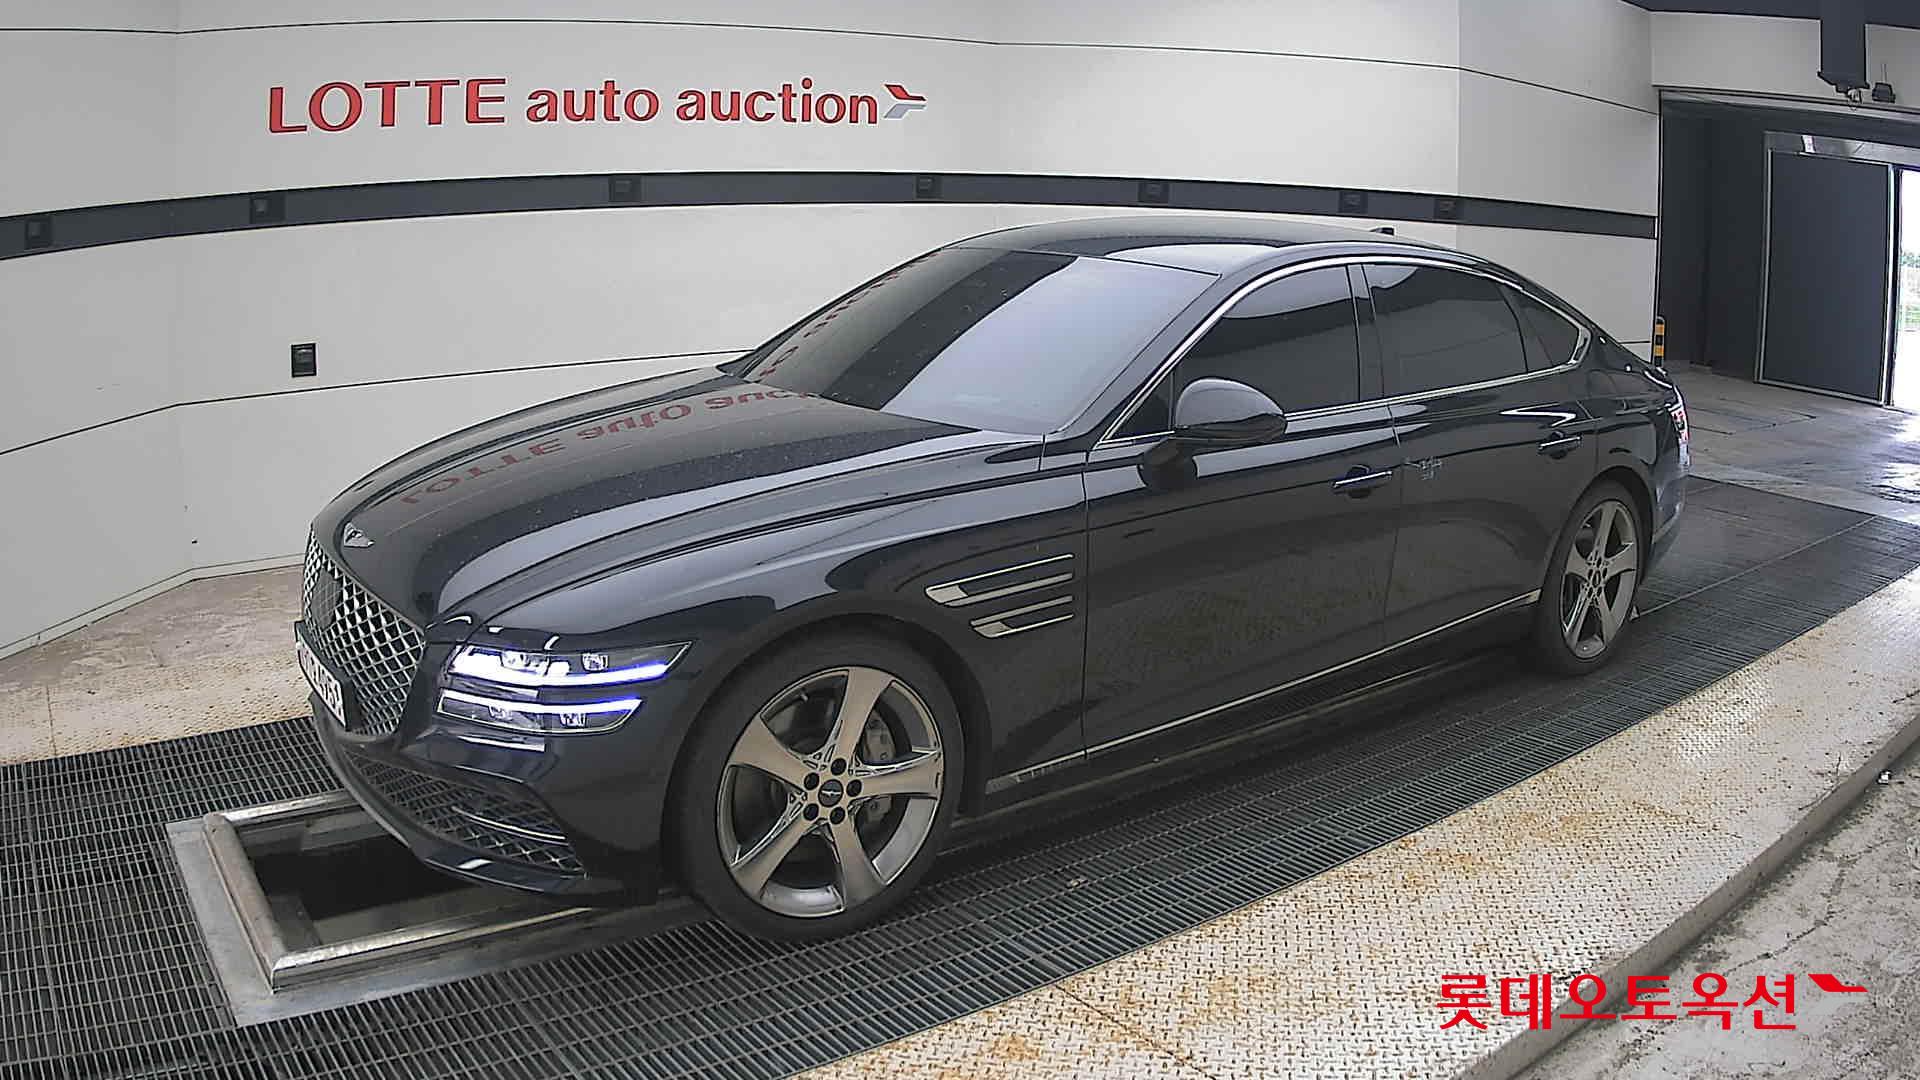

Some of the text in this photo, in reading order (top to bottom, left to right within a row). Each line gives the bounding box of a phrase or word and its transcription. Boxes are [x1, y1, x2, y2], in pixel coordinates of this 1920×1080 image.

[269, 79, 878, 133] LOTTE auto auction
